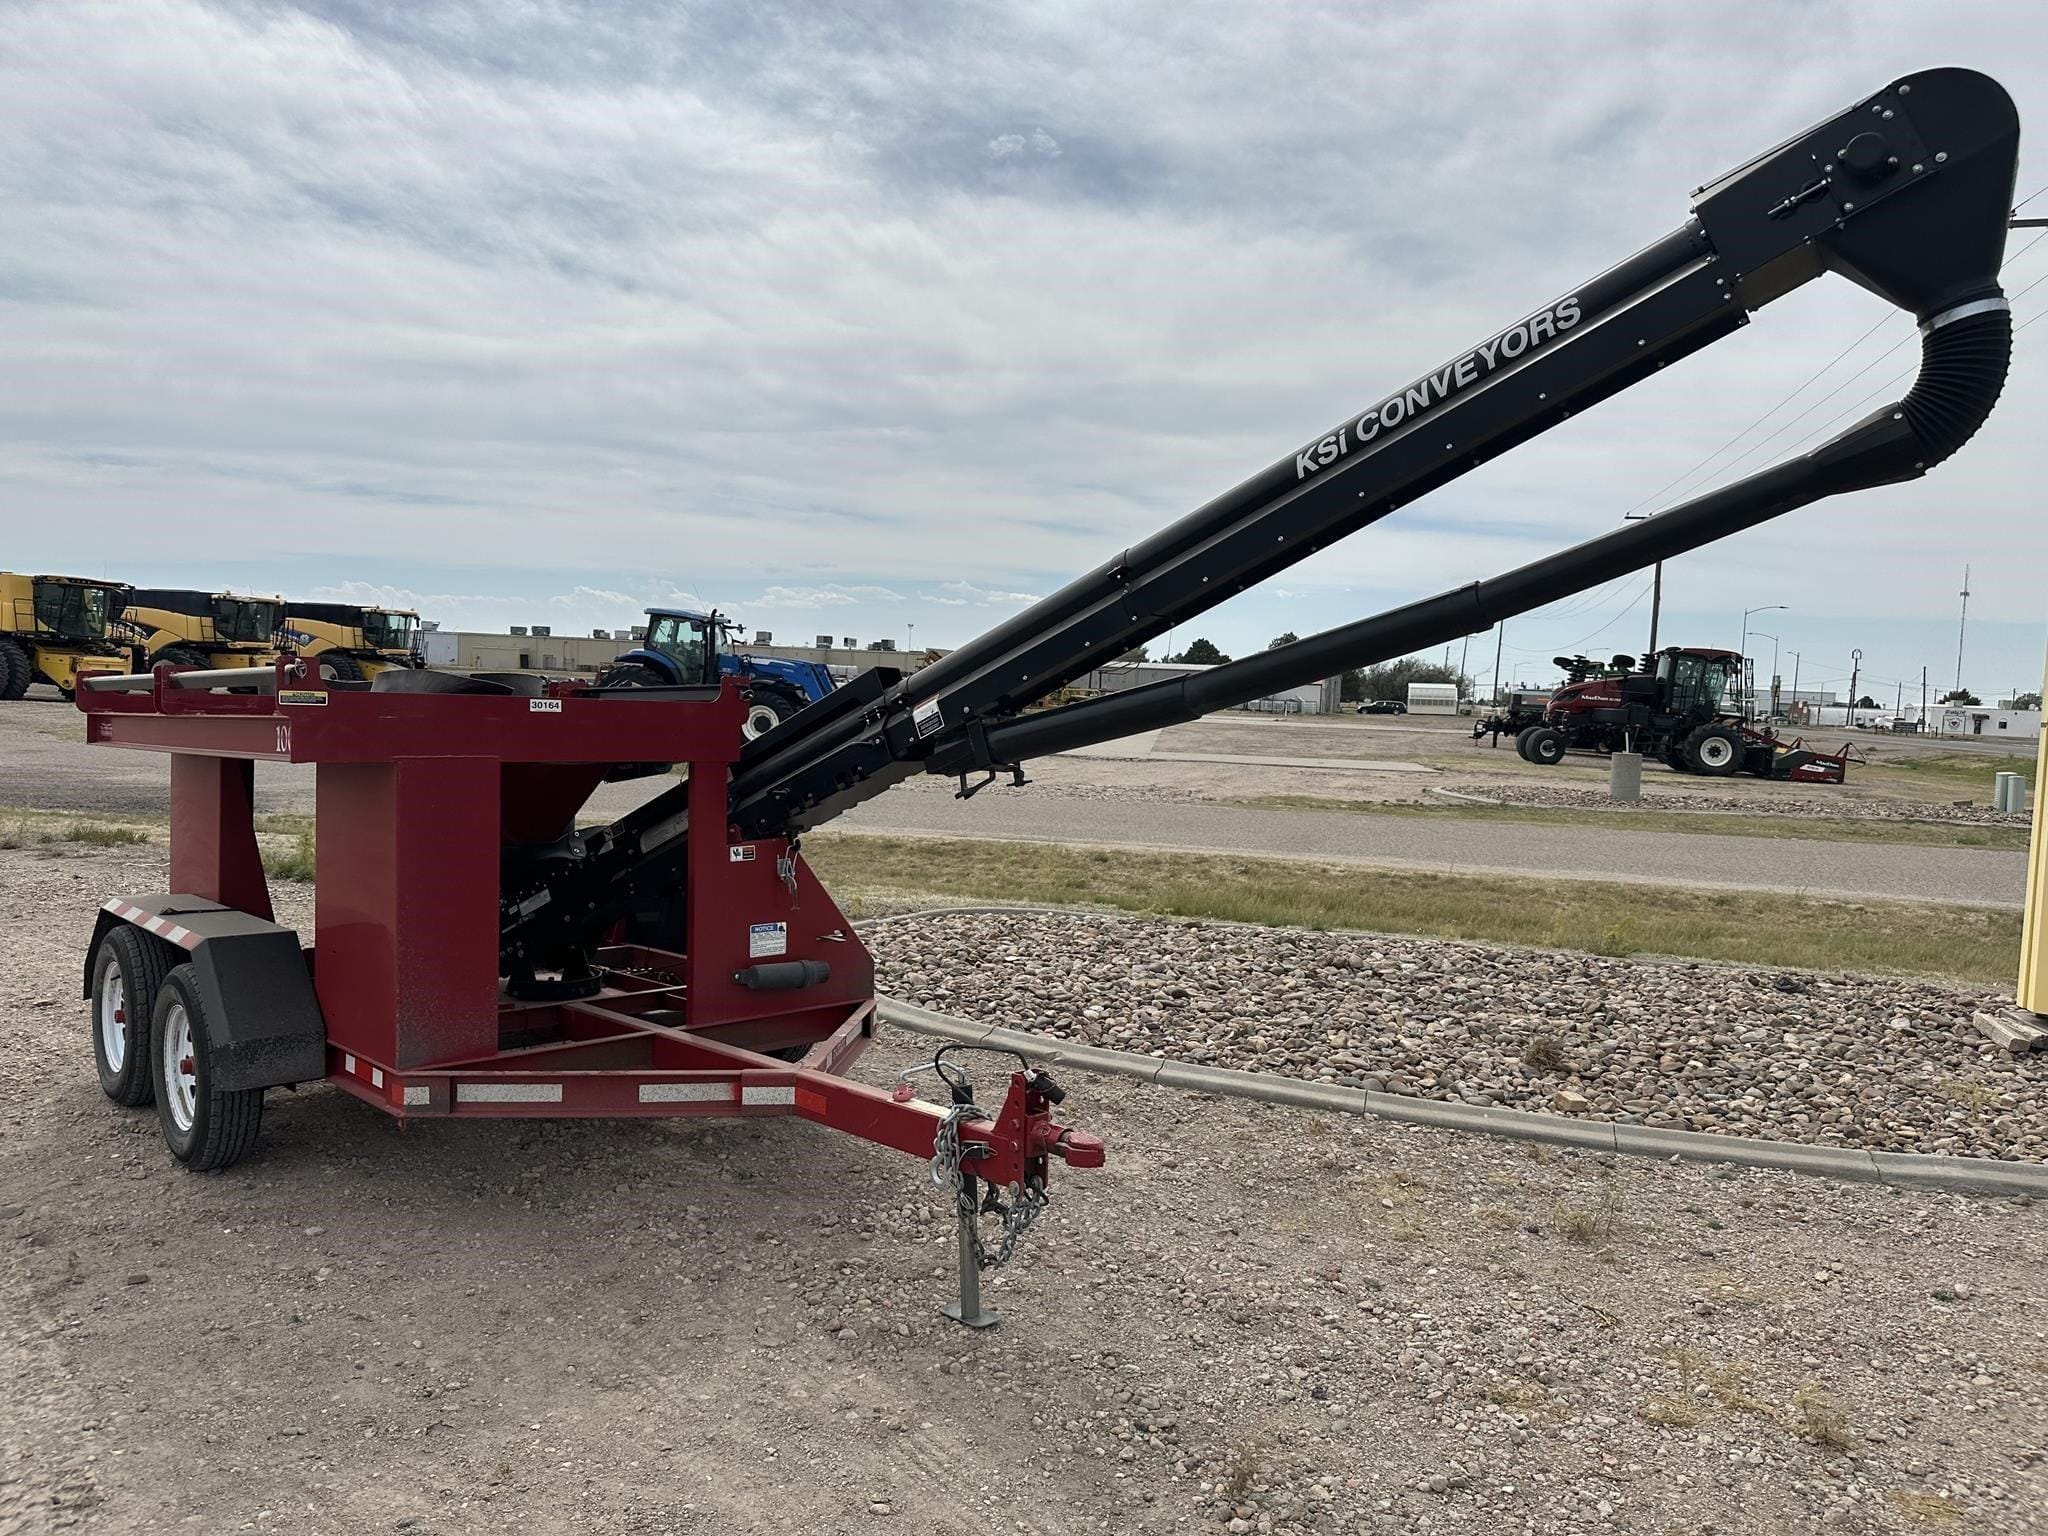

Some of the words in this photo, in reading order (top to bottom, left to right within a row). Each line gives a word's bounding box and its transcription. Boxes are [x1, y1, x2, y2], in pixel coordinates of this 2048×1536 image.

[1296, 429, 1349, 480] KSi
[1356, 297, 1582, 442] CONVEYORS
[531, 701, 560, 710] 30164
